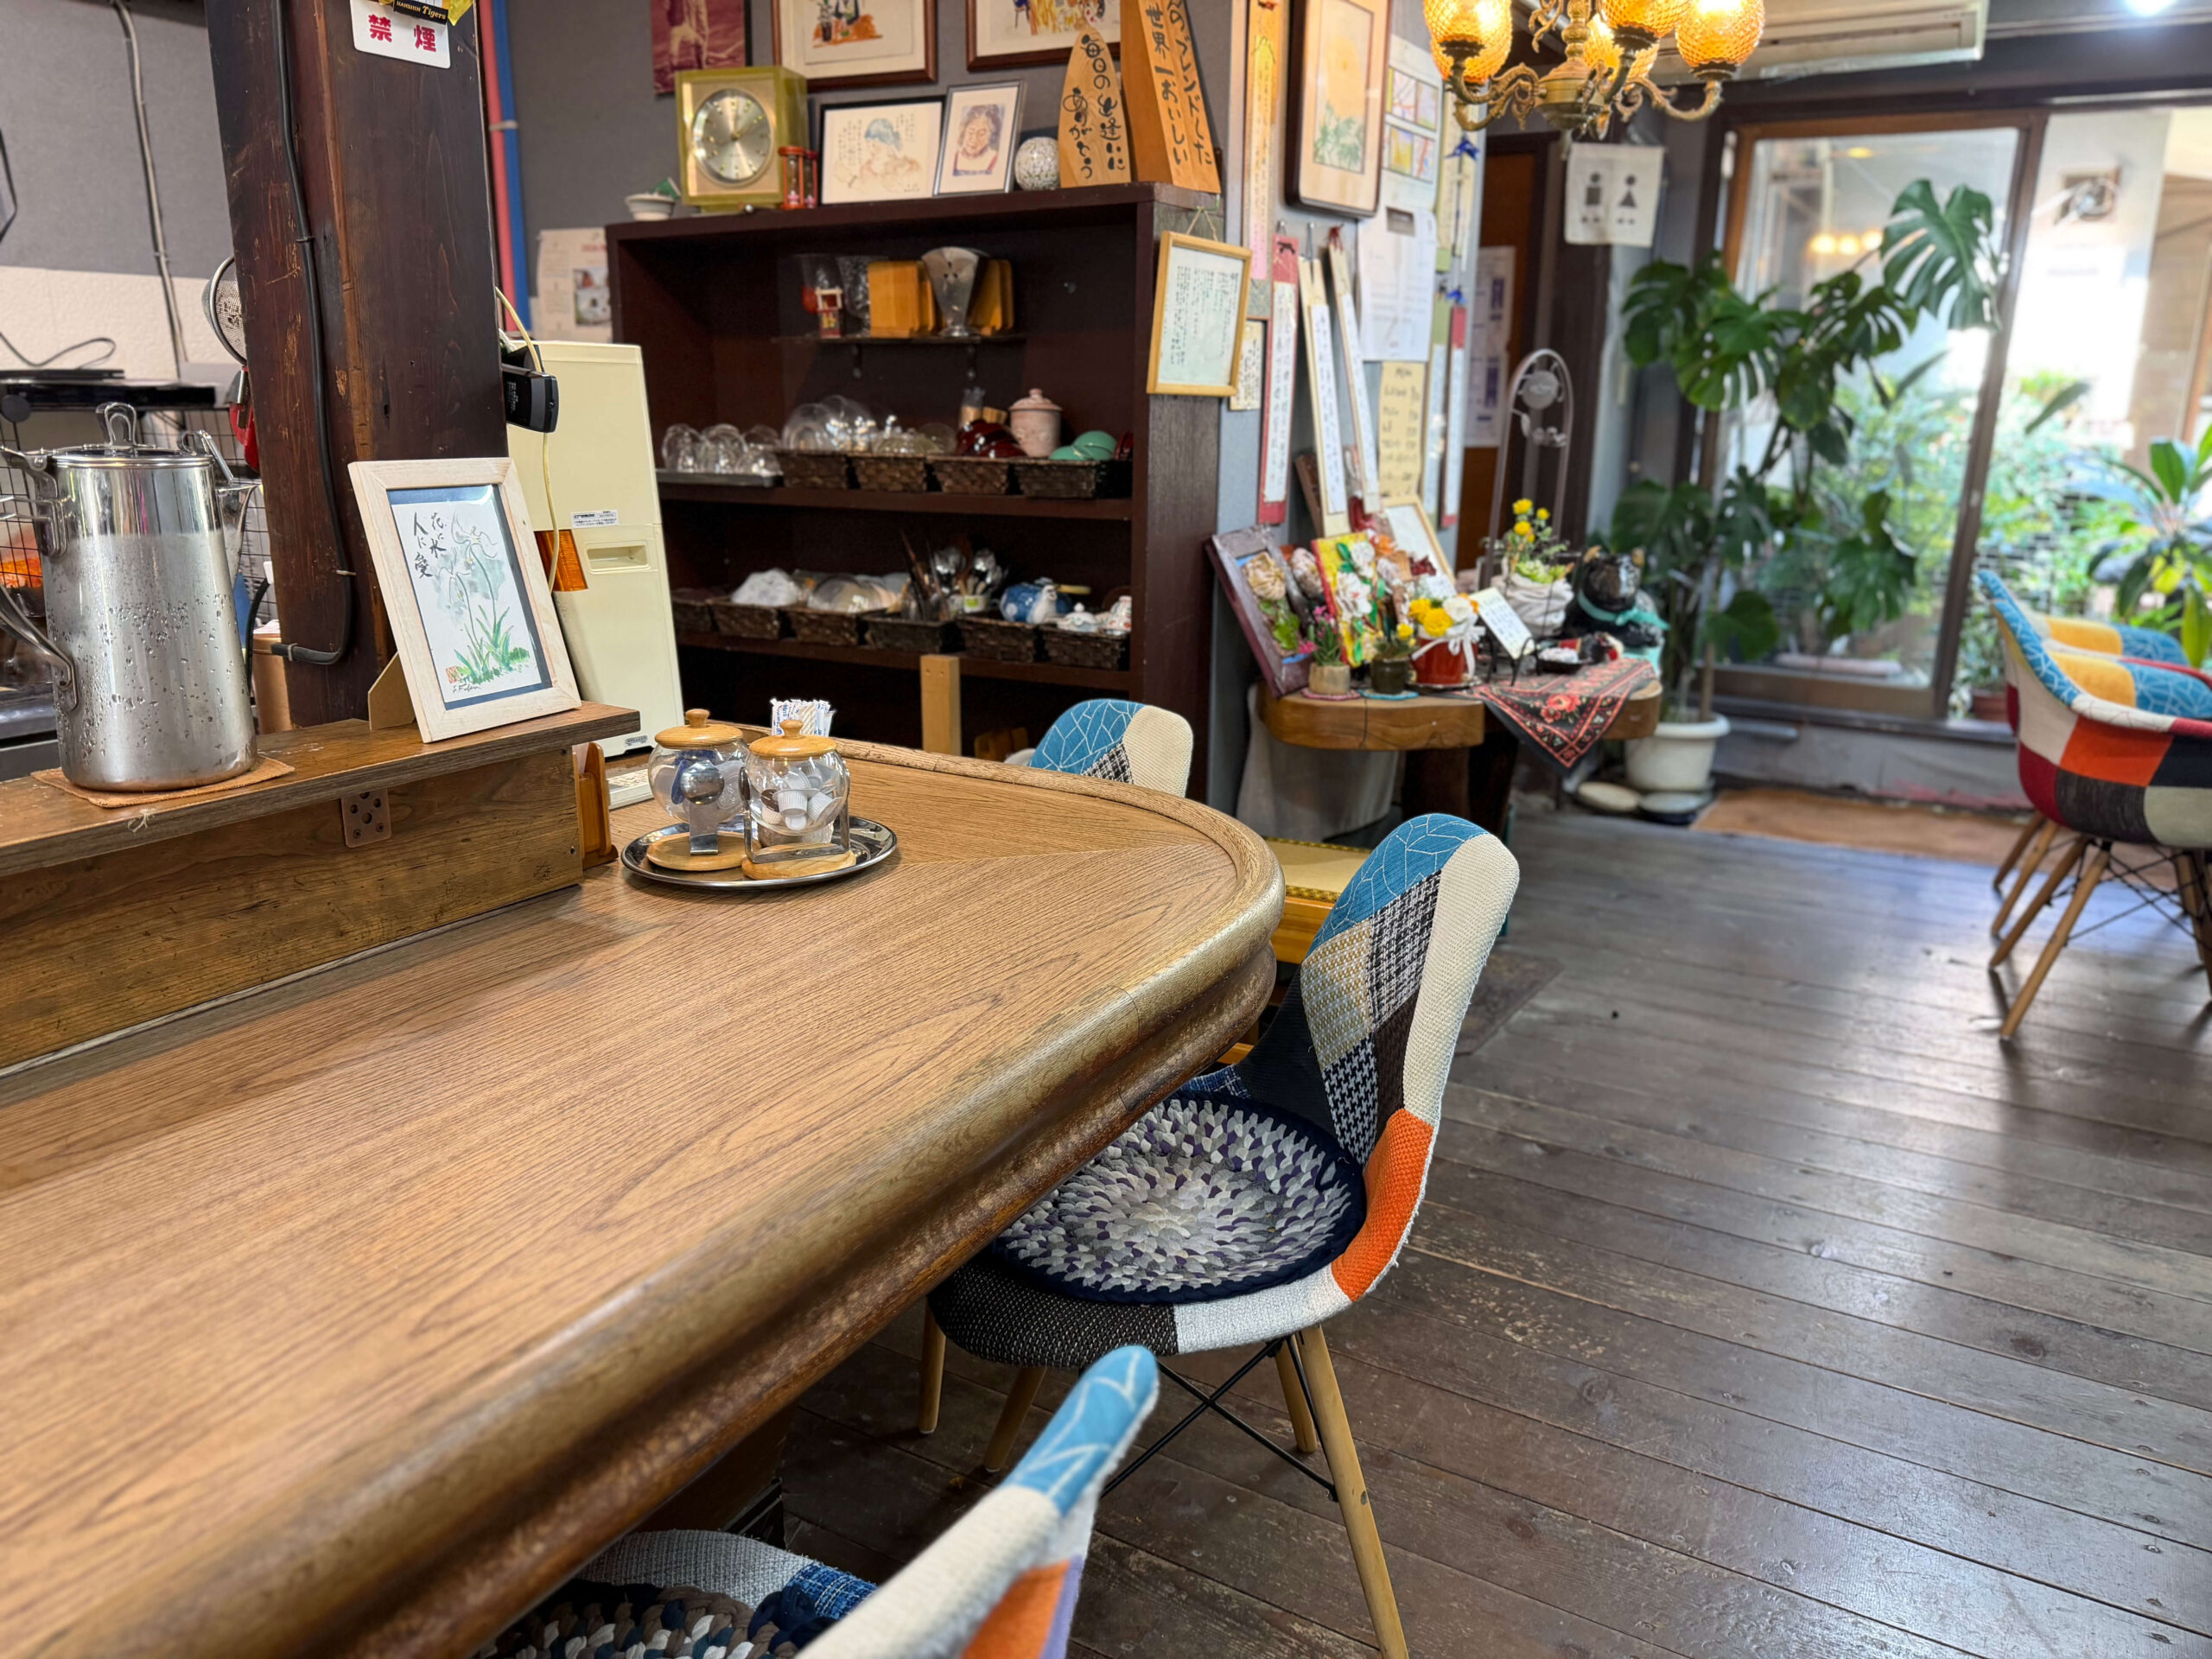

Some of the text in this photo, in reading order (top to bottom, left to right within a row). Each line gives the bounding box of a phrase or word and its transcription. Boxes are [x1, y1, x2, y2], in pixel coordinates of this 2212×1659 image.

[368, 14, 436, 53] 禁煙
[423, 5, 446, 19] Tigers
[1145, 3, 1188, 166] 世界一おいしい
[1063, 86, 1093, 179] ありがとう
[413, 512, 433, 579] 人に愛
